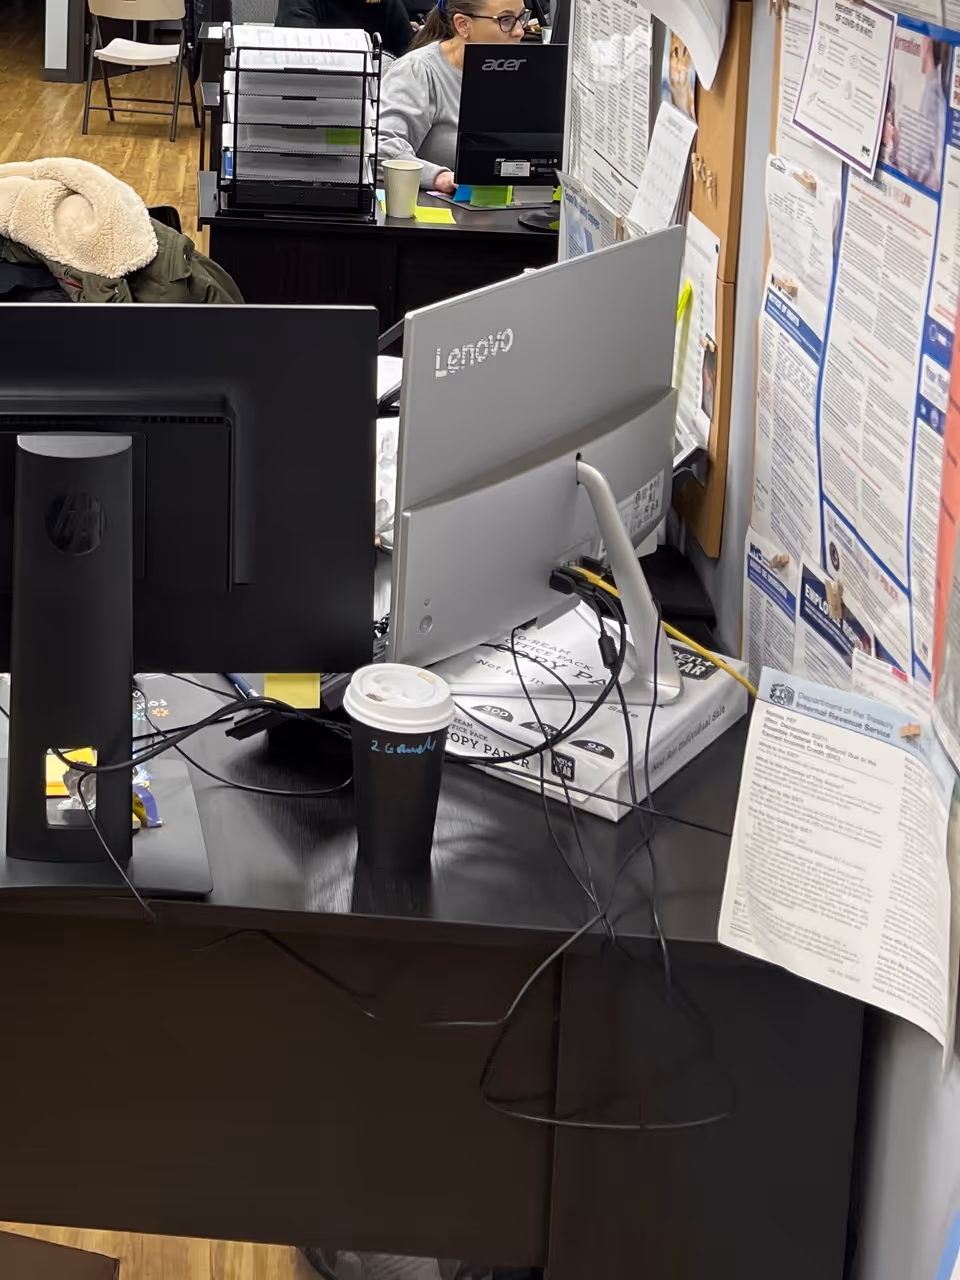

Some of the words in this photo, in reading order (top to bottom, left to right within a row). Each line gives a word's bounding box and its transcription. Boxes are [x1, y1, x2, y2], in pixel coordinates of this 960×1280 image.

[481, 58, 527, 71] acer
[435, 328, 514, 379] Lenovo
[476, 659, 501, 671] Not
[556, 655, 593, 671] PACK
[482, 705, 510, 718] 500
[712, 705, 726, 721] Sale
[798, 691, 843, 713] Department
[852, 709, 865, 720] the
[866, 712, 894, 730] Treasury
[795, 701, 828, 717] Internal
[828, 711, 863, 729] Revenue
[863, 723, 891, 739] Service
[779, 721, 810, 736] December
[783, 737, 806, 750] Income
[806, 745, 825, 757] Credit
[788, 731, 812, 744] Federal
[812, 740, 824, 748] Tax
[847, 752, 860, 761] Due
[867, 759, 877, 767] the
